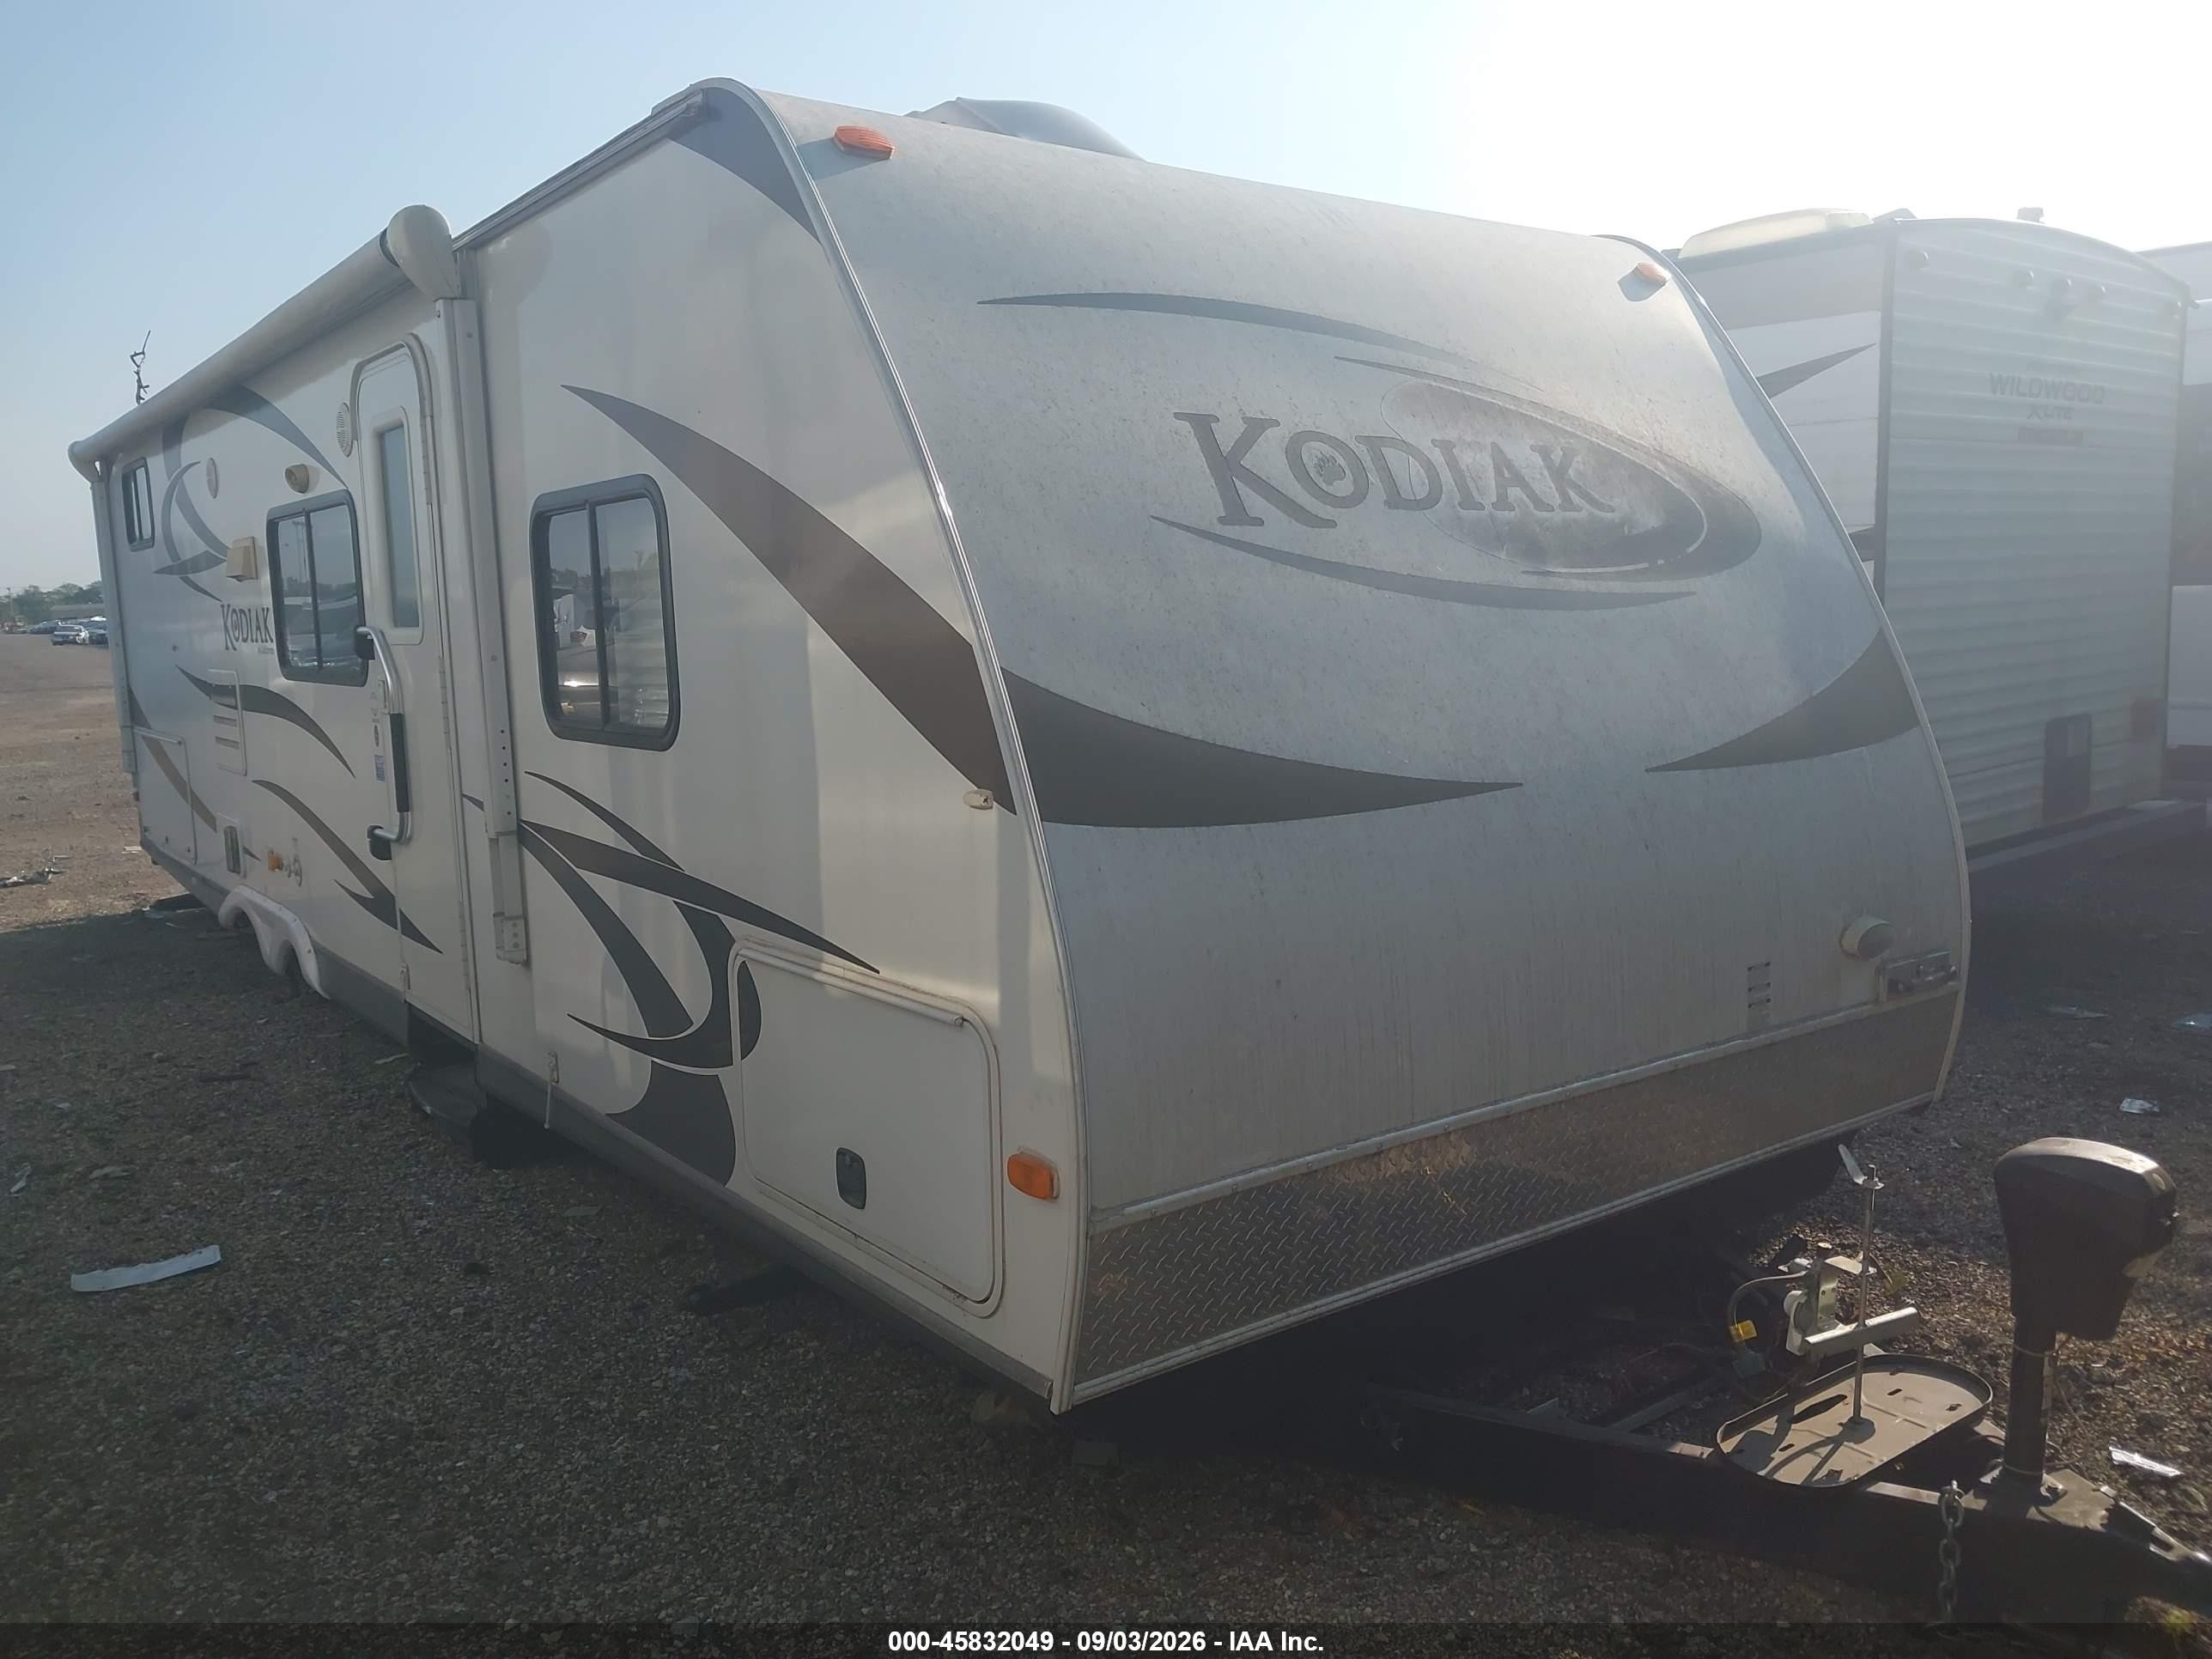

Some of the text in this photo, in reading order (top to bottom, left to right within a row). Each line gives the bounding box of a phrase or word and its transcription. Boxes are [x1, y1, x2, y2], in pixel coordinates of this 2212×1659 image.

[1989, 373, 2105, 404] WILDWOOD
[1173, 412, 1615, 529] KODIAK
[221, 604, 274, 651] KODIAK
